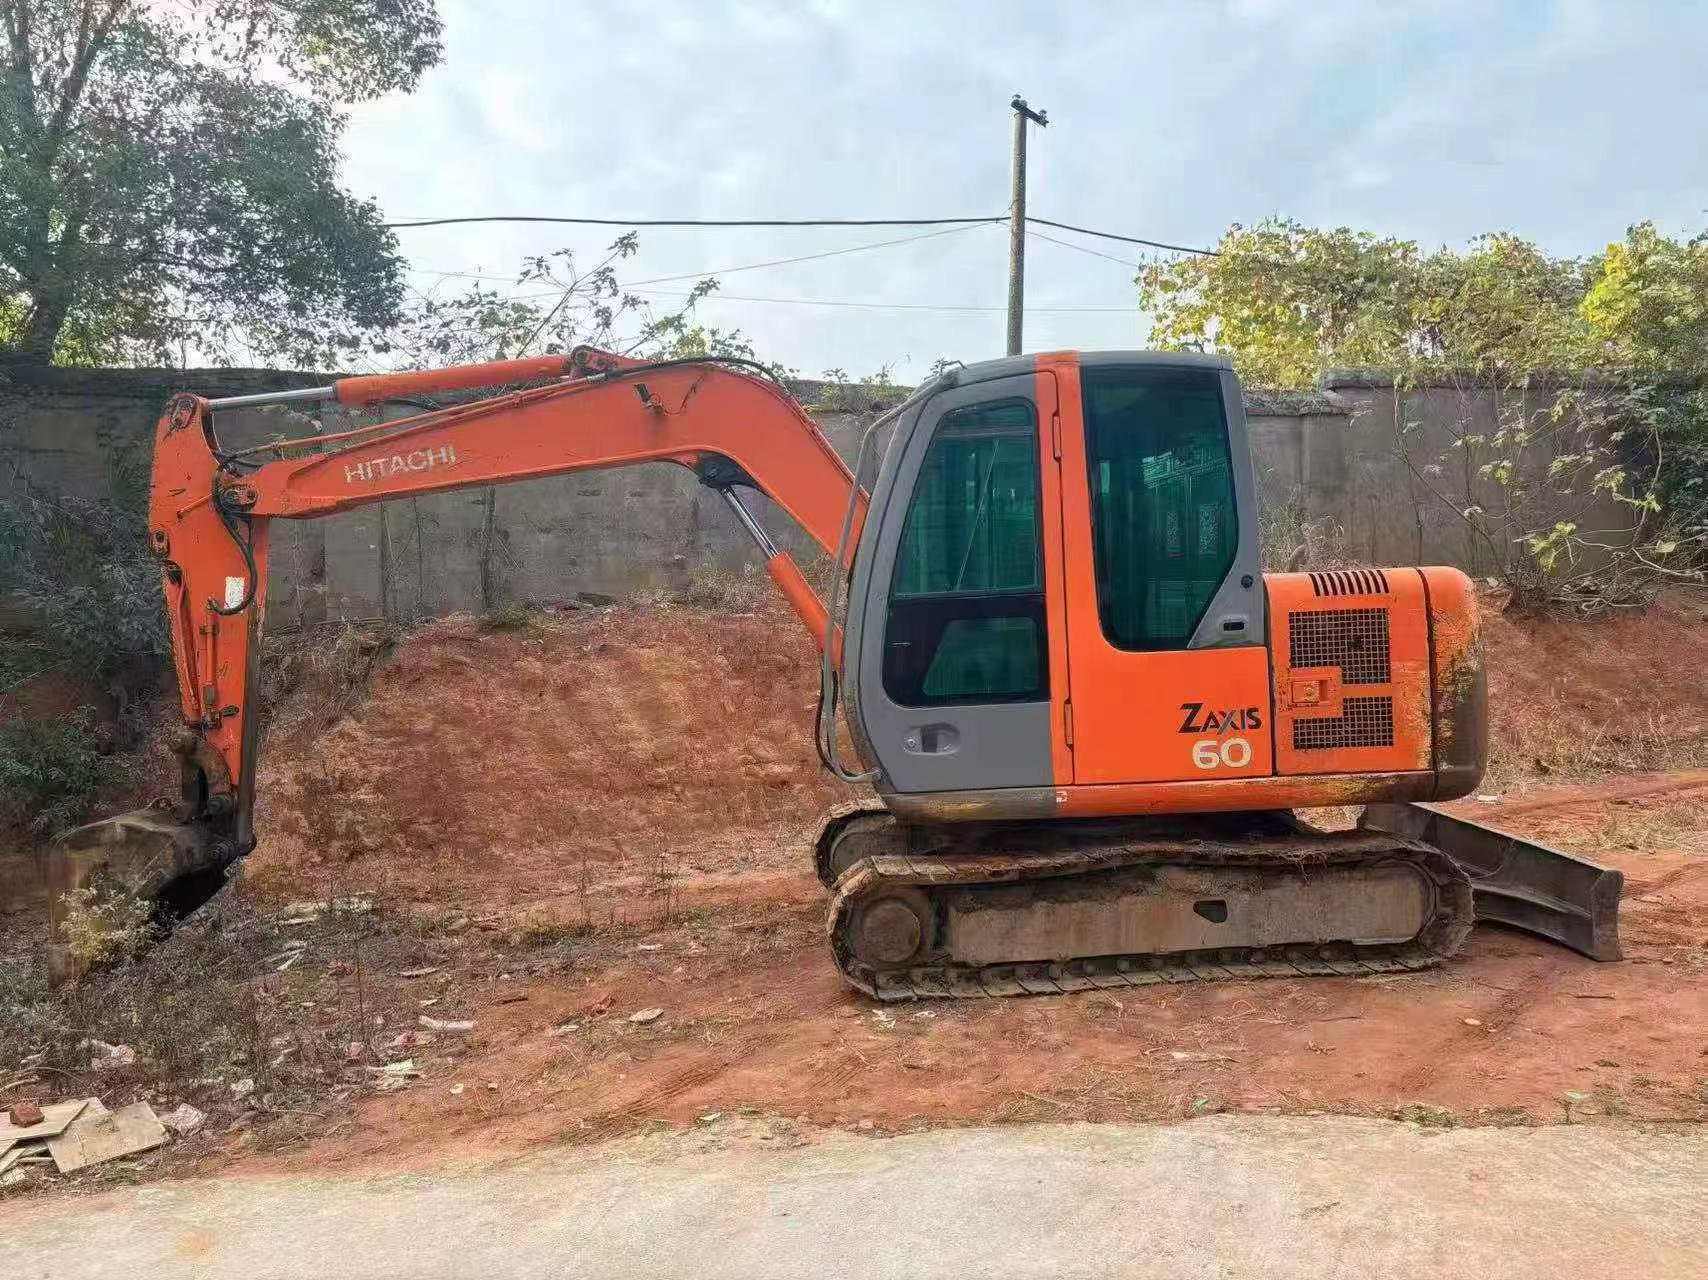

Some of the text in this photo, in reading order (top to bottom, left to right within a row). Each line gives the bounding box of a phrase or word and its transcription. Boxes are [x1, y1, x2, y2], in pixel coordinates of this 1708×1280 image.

[344, 444, 456, 483] HITACHI
[1178, 702, 1262, 735] ZAXIS
[1192, 737, 1252, 769] 60
